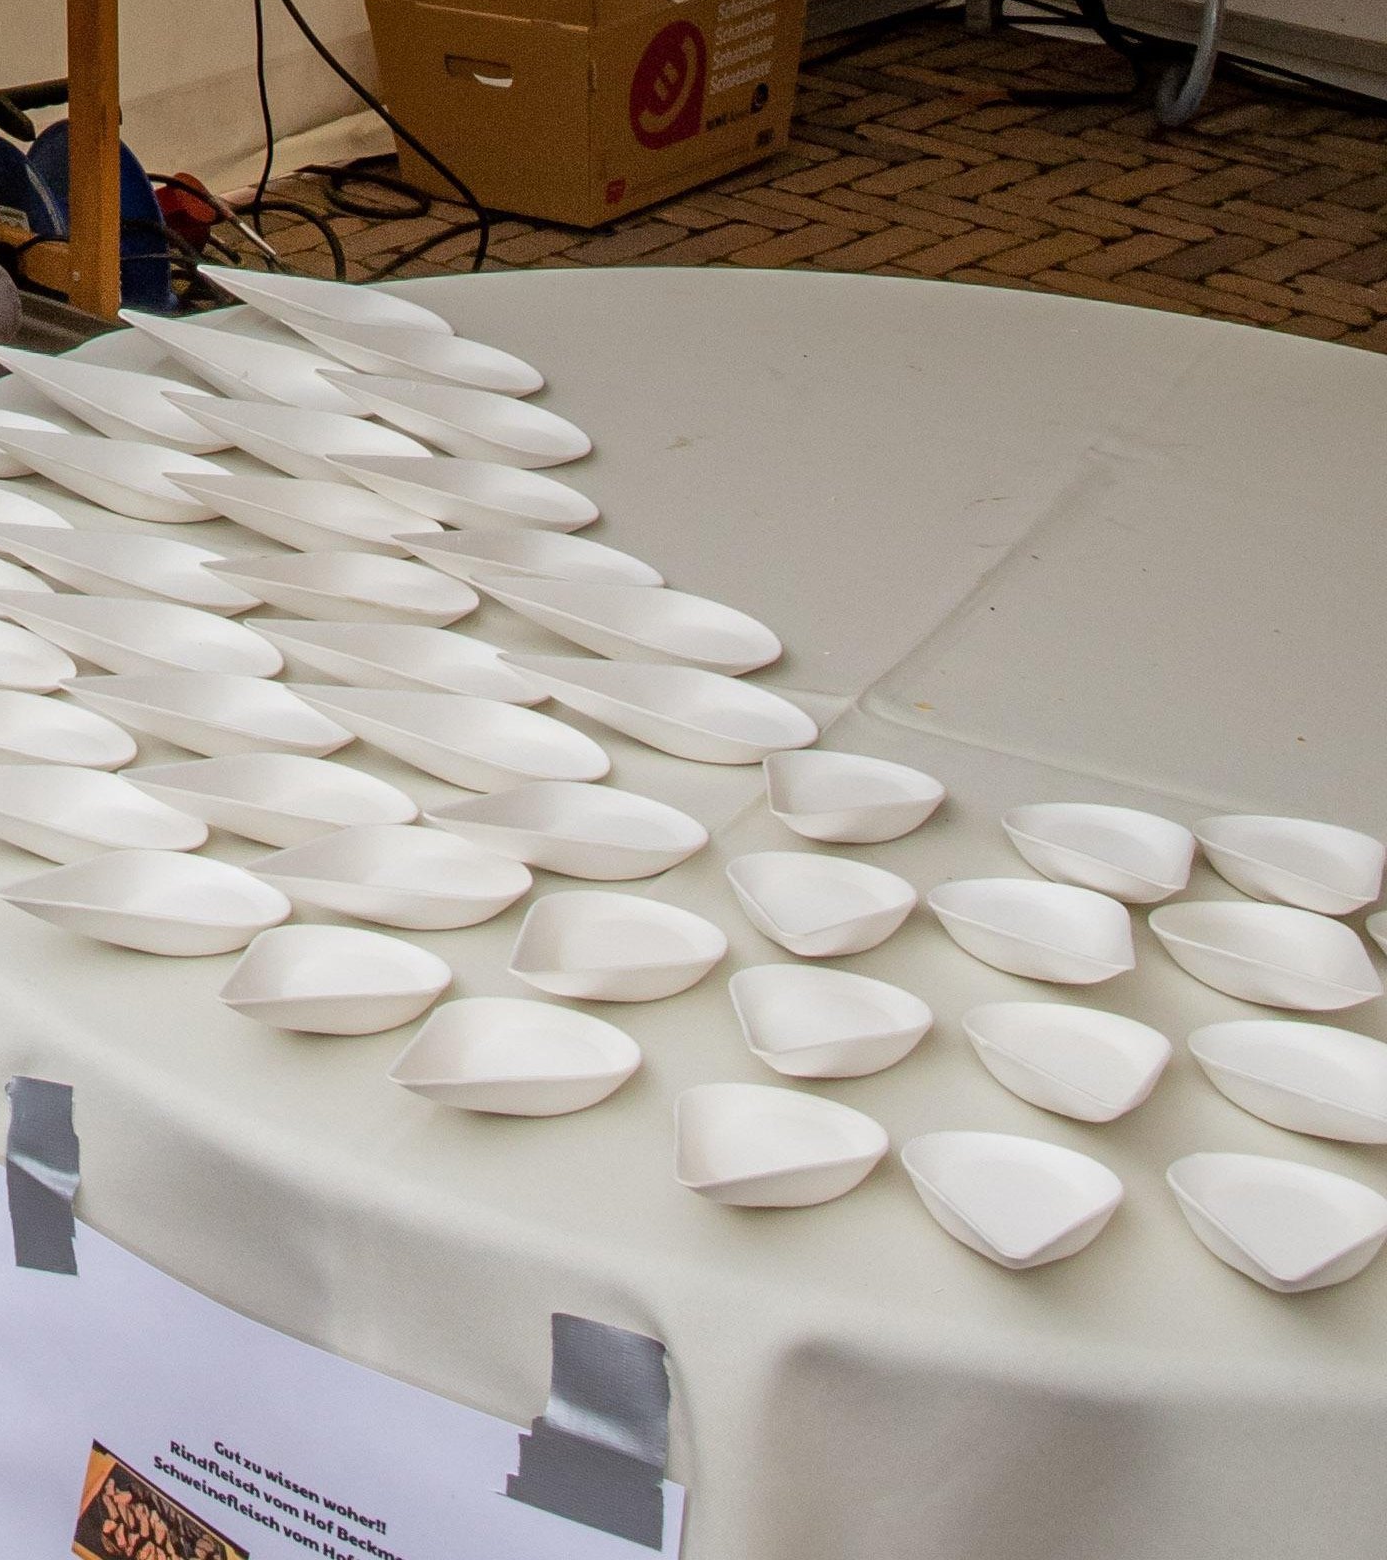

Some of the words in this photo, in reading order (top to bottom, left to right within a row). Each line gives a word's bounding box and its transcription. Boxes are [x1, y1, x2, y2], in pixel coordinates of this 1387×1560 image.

[153, 1455, 280, 1532] Schweinefleisch
[283, 1525, 319, 1553] vom
[169, 1440, 261, 1498] Rindfleisch
[263, 1492, 299, 1518] vom
[303, 1509, 334, 1534] Hof
[337, 1525, 404, 1560] Beckm
[213, 1440, 242, 1465] Gut
[243, 1458, 262, 1475] zu
[264, 1468, 320, 1503] wissen
[323, 1498, 387, 1535] woher!!
